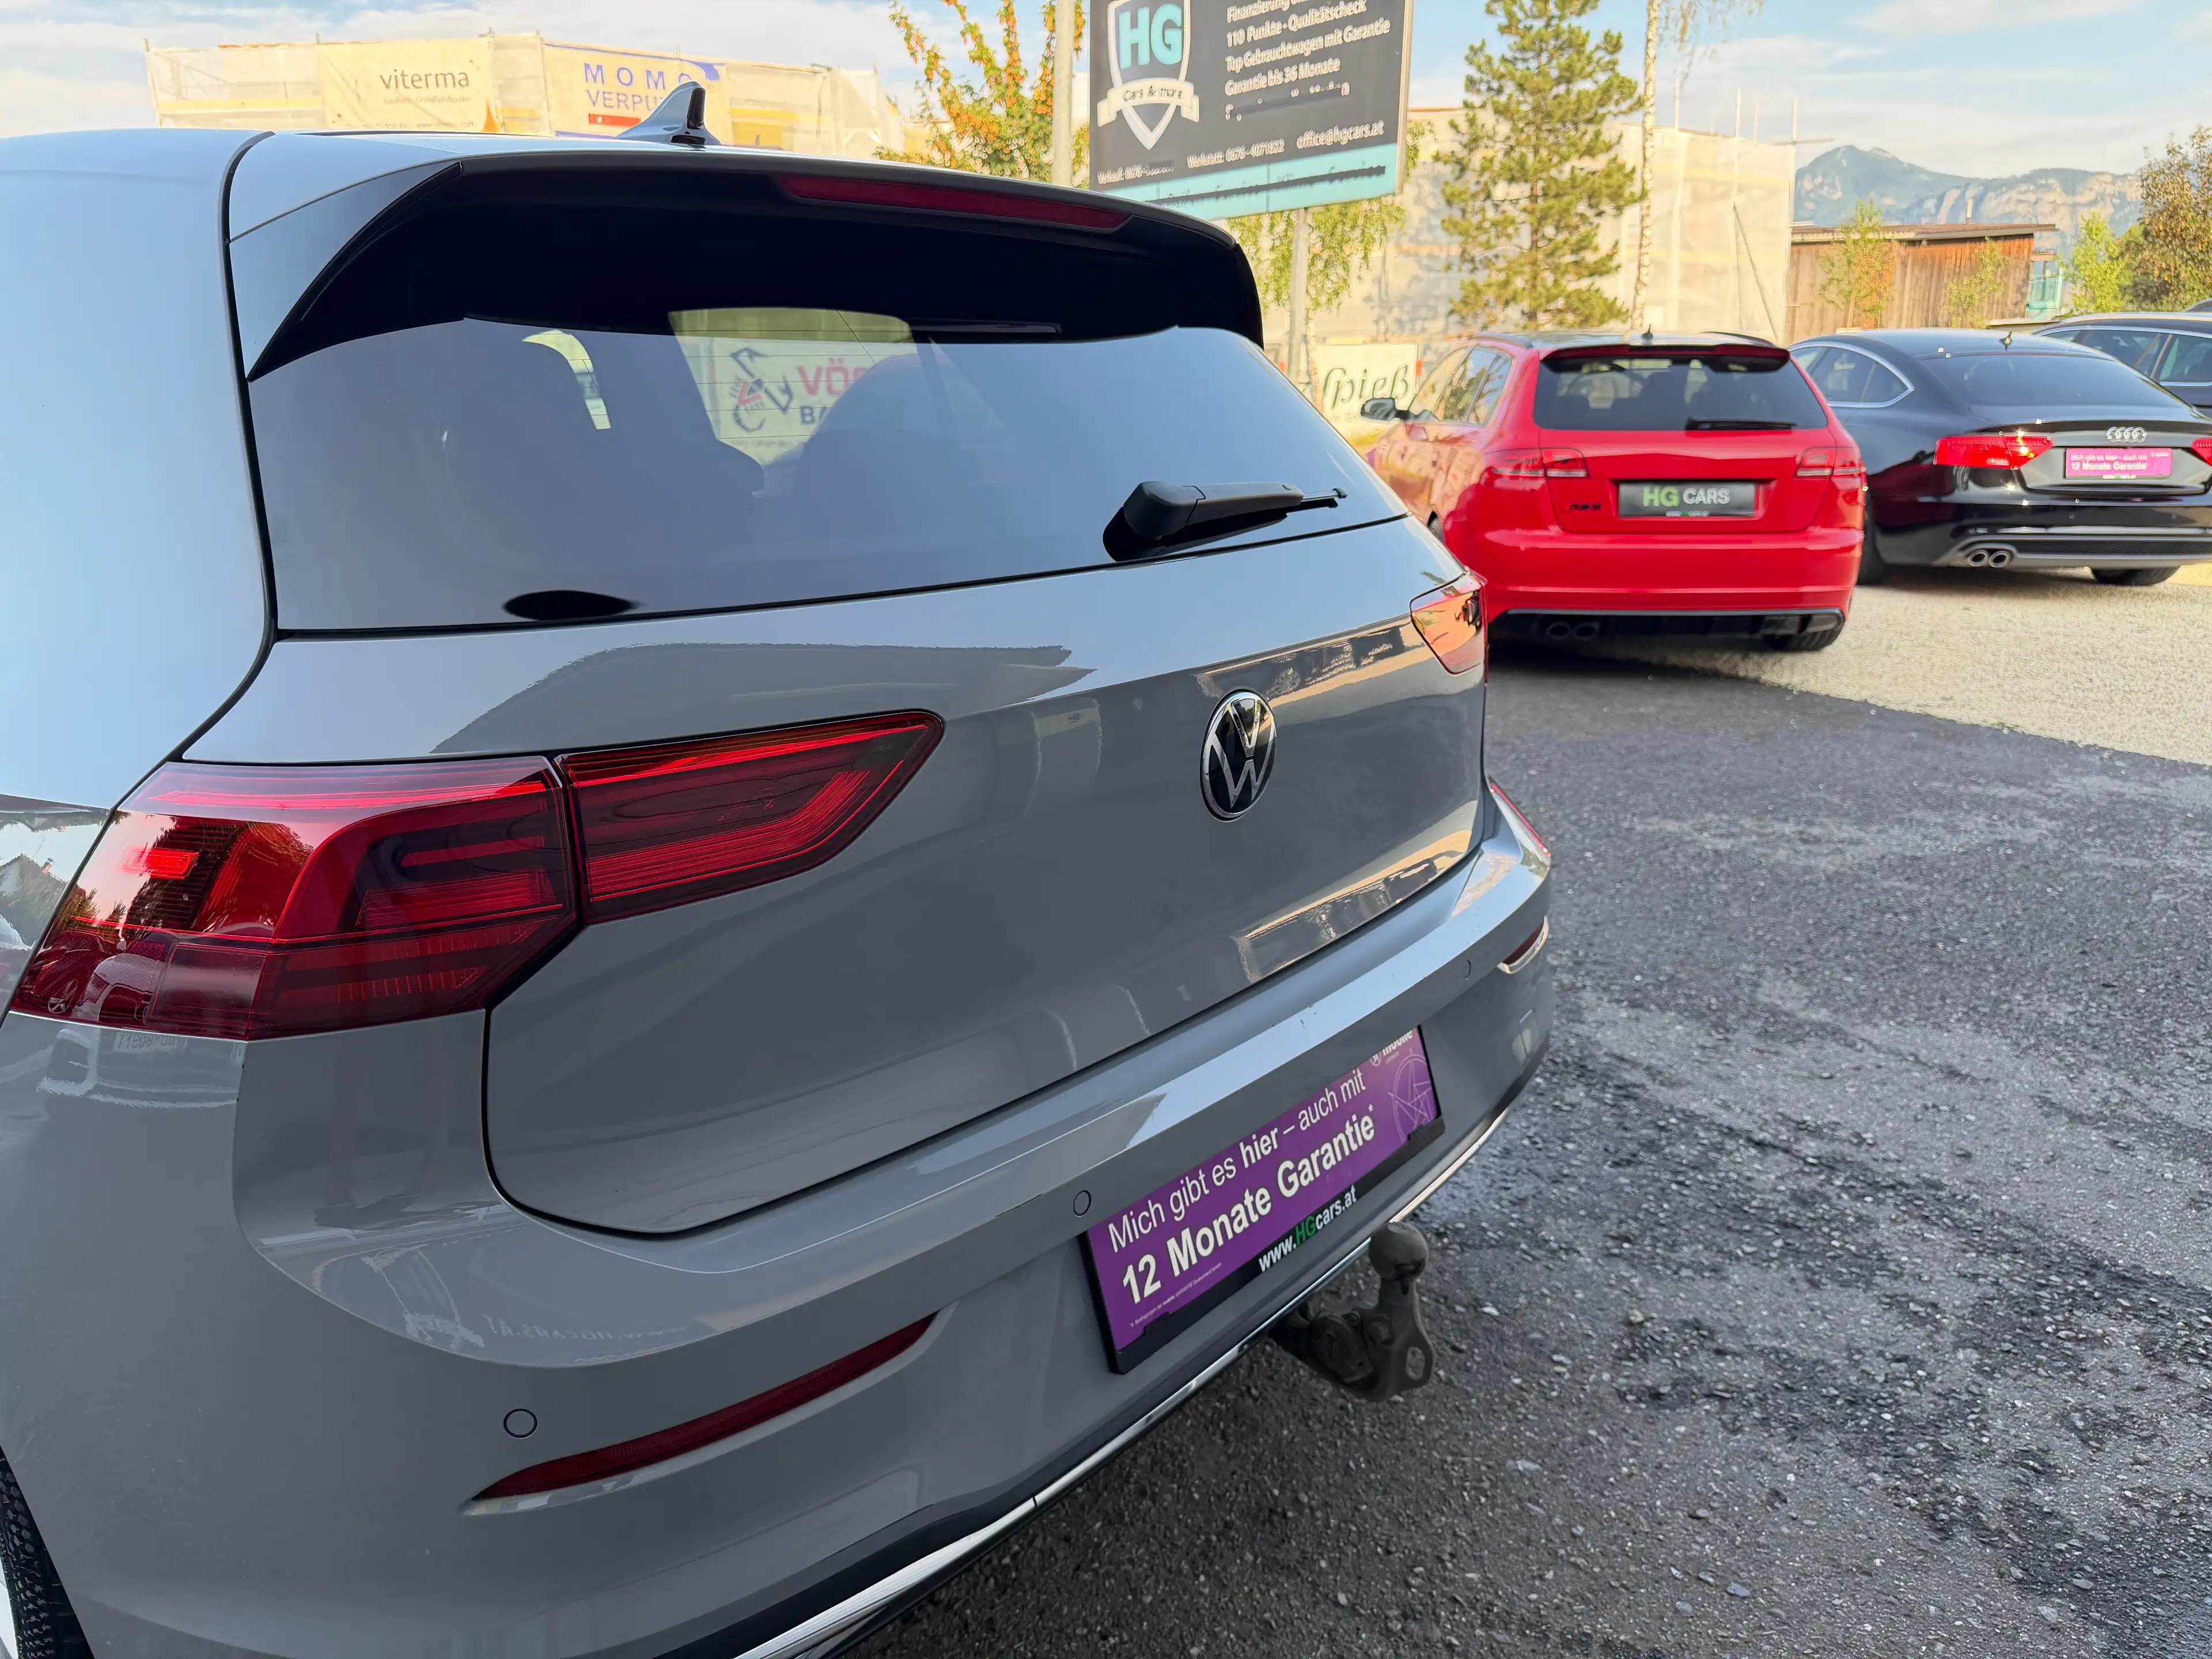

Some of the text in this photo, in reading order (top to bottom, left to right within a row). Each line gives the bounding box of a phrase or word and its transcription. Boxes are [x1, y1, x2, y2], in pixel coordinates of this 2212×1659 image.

[1118, 3, 1182, 69] HG
[1225, 17, 1391, 73] Top Gebrauchtwagen mit Garantie
[1226, 28, 1245, 47] 110
[1247, 20, 1282, 42] Punkte
[379, 69, 469, 90] viterma
[1147, 86, 1157, 97] &
[1225, 58, 1340, 96] Garantie bis 36 Monate
[585, 89, 664, 112] VERPU
[1296, 120, 1384, 150] office@hgcars.at
[1643, 487, 1730, 507] HG CARS
[1107, 1201, 1166, 1252] Mich
[1169, 1169, 1210, 1221] gibt
[1211, 1157, 1237, 1186] es
[1238, 1129, 1279, 1168] hier
[1298, 1090, 1339, 1131] auch
[1341, 1067, 1367, 1101] mit
[1121, 1253, 1162, 1305] 12
[1166, 1185, 1272, 1277] Monate
[1259, 1184, 1358, 1272] www.HGcars.at
